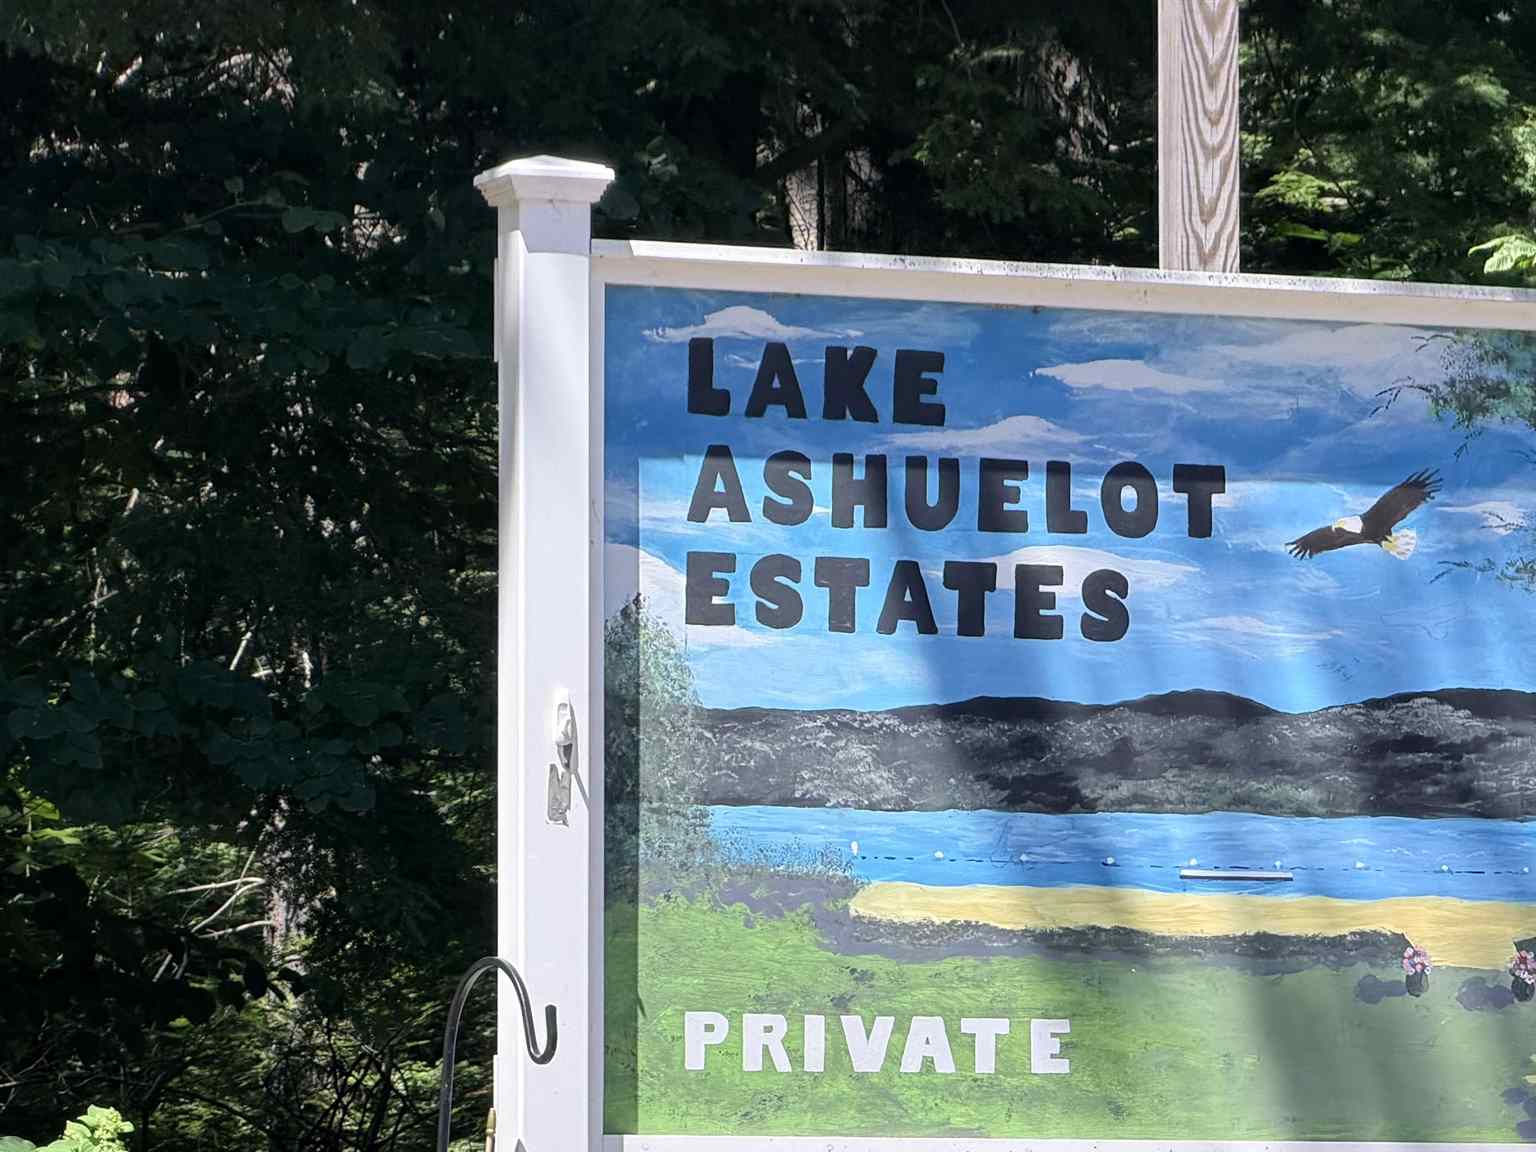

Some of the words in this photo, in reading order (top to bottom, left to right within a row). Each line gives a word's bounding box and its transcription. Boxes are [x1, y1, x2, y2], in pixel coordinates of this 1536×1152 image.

[687, 337, 946, 426] LAKE
[687, 444, 1226, 538] ASHUELOT
[685, 550, 1130, 642] ESTATES
[684, 1011, 1071, 1074] PRIVATE
